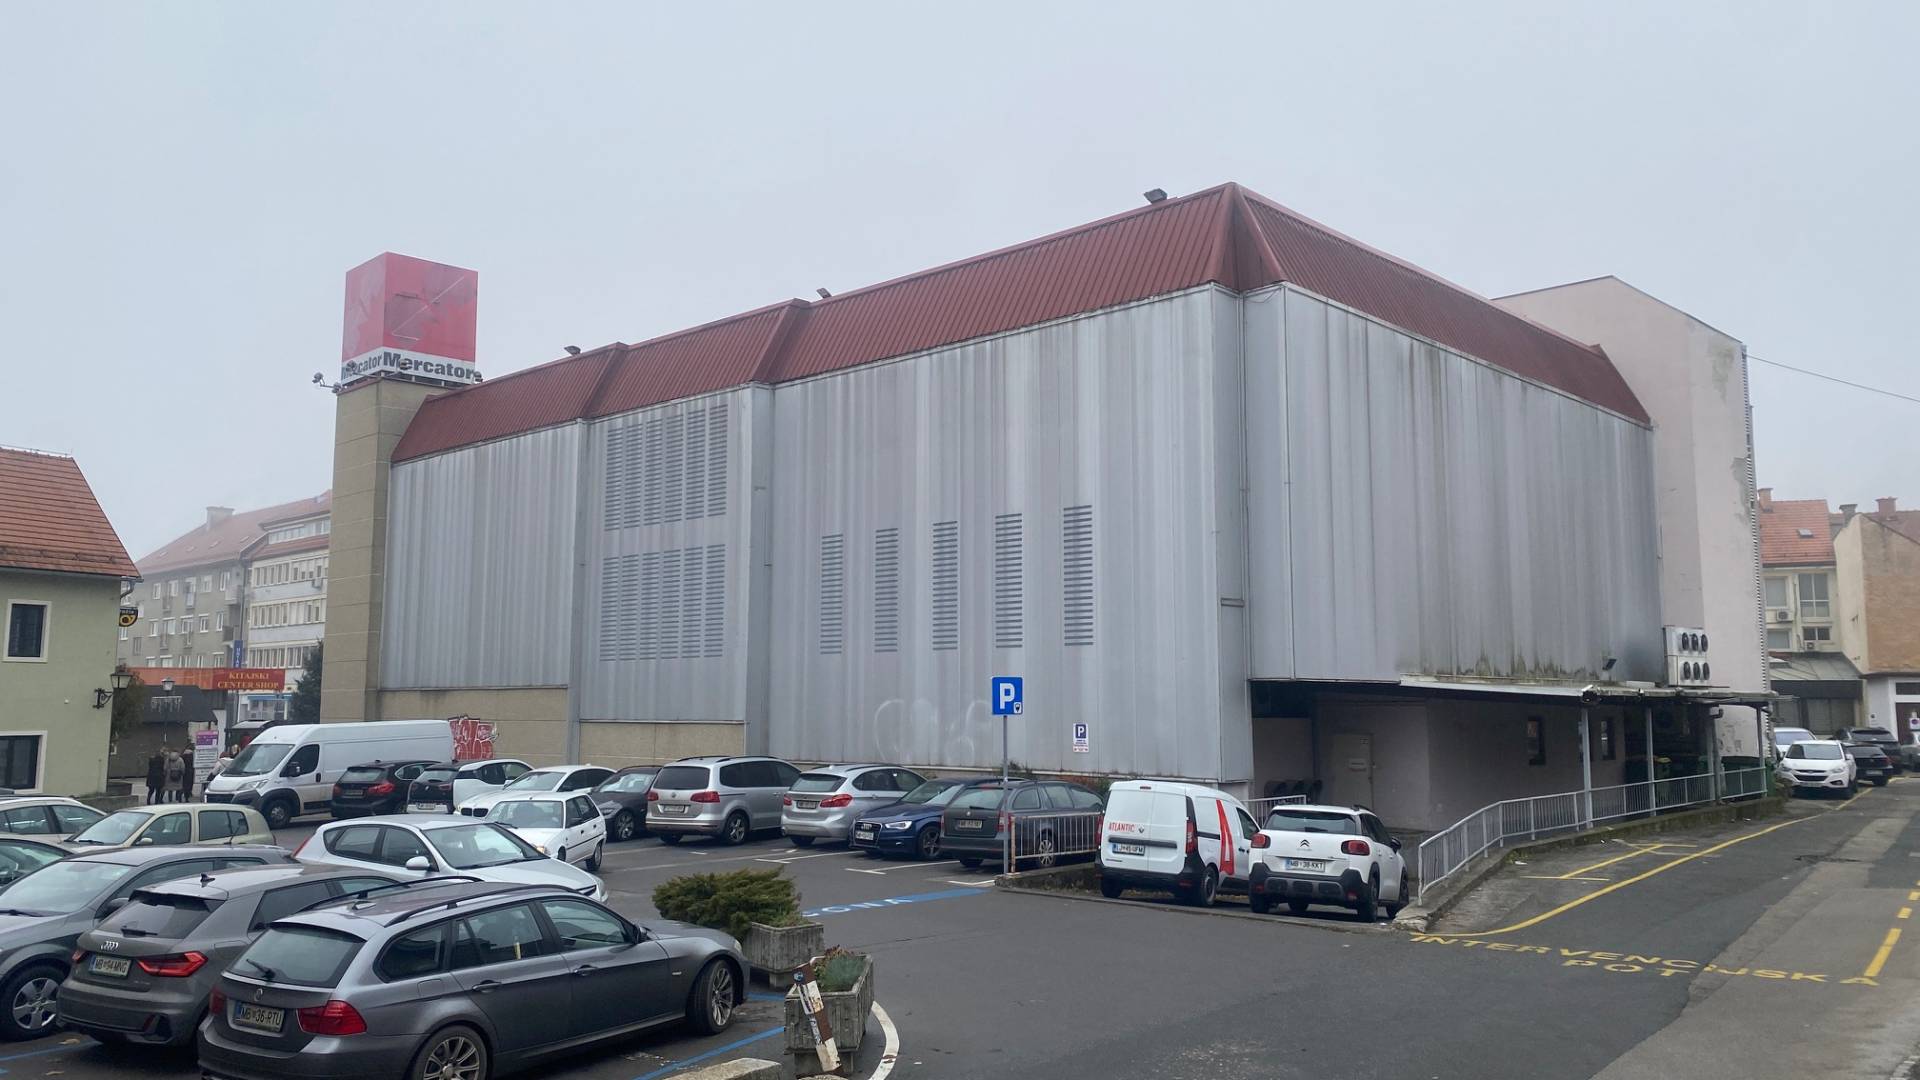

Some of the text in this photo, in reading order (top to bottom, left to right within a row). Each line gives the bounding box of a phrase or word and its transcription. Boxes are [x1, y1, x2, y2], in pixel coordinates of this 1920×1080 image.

[383, 351, 475, 379] Mercator
[229, 672, 270, 680] KITAJSKI
[217, 681, 279, 689] CENTER SHOP
[999, 683, 1015, 709] P
[1077, 725, 1085, 737] P
[1109, 822, 1135, 833] ATLANTIC
[1561, 959, 1691, 977] POT
